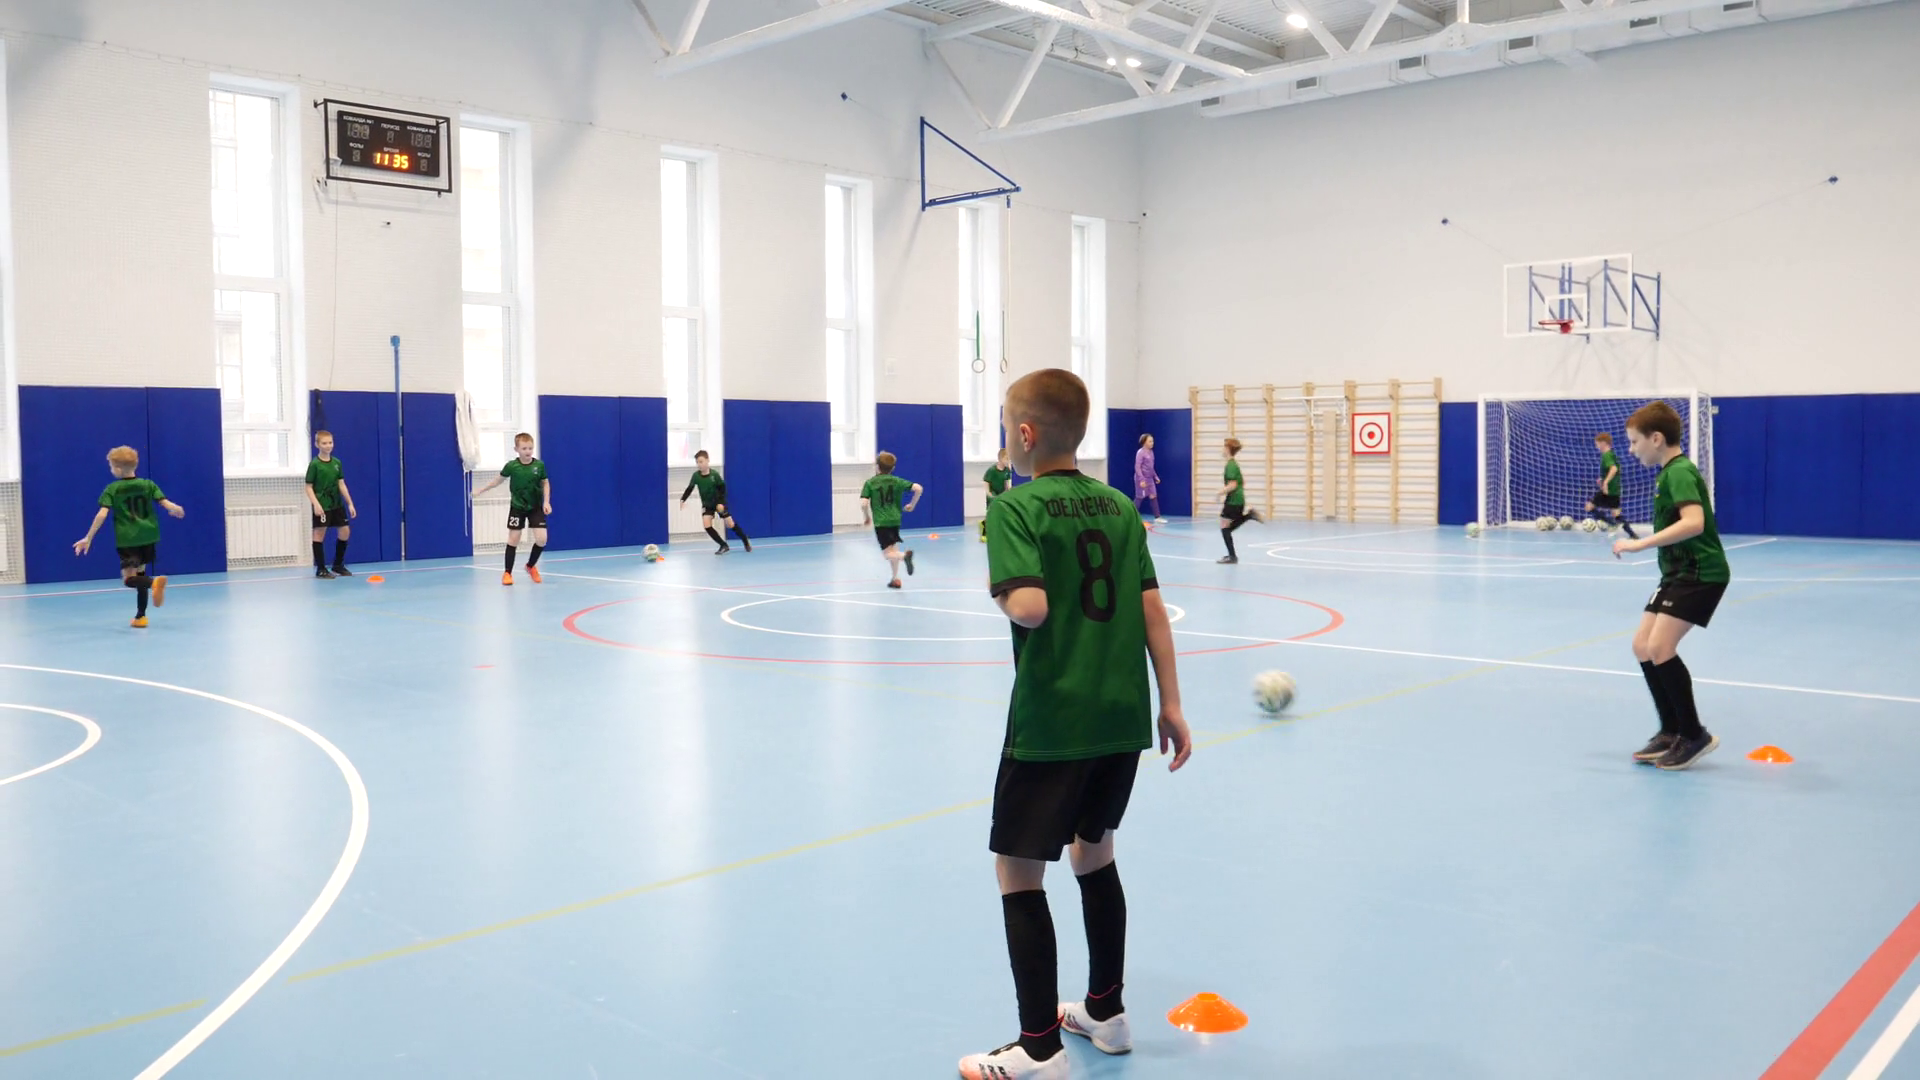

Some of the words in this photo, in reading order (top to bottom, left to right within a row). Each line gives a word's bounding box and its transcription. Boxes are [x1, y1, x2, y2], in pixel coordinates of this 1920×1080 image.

[123, 494, 149, 522] 10
[876, 484, 894, 508] 14
[1046, 497, 1122, 519] ФЕДЧЕНКО
[509, 516, 520, 527] 23
[1075, 529, 1116, 623] 8
